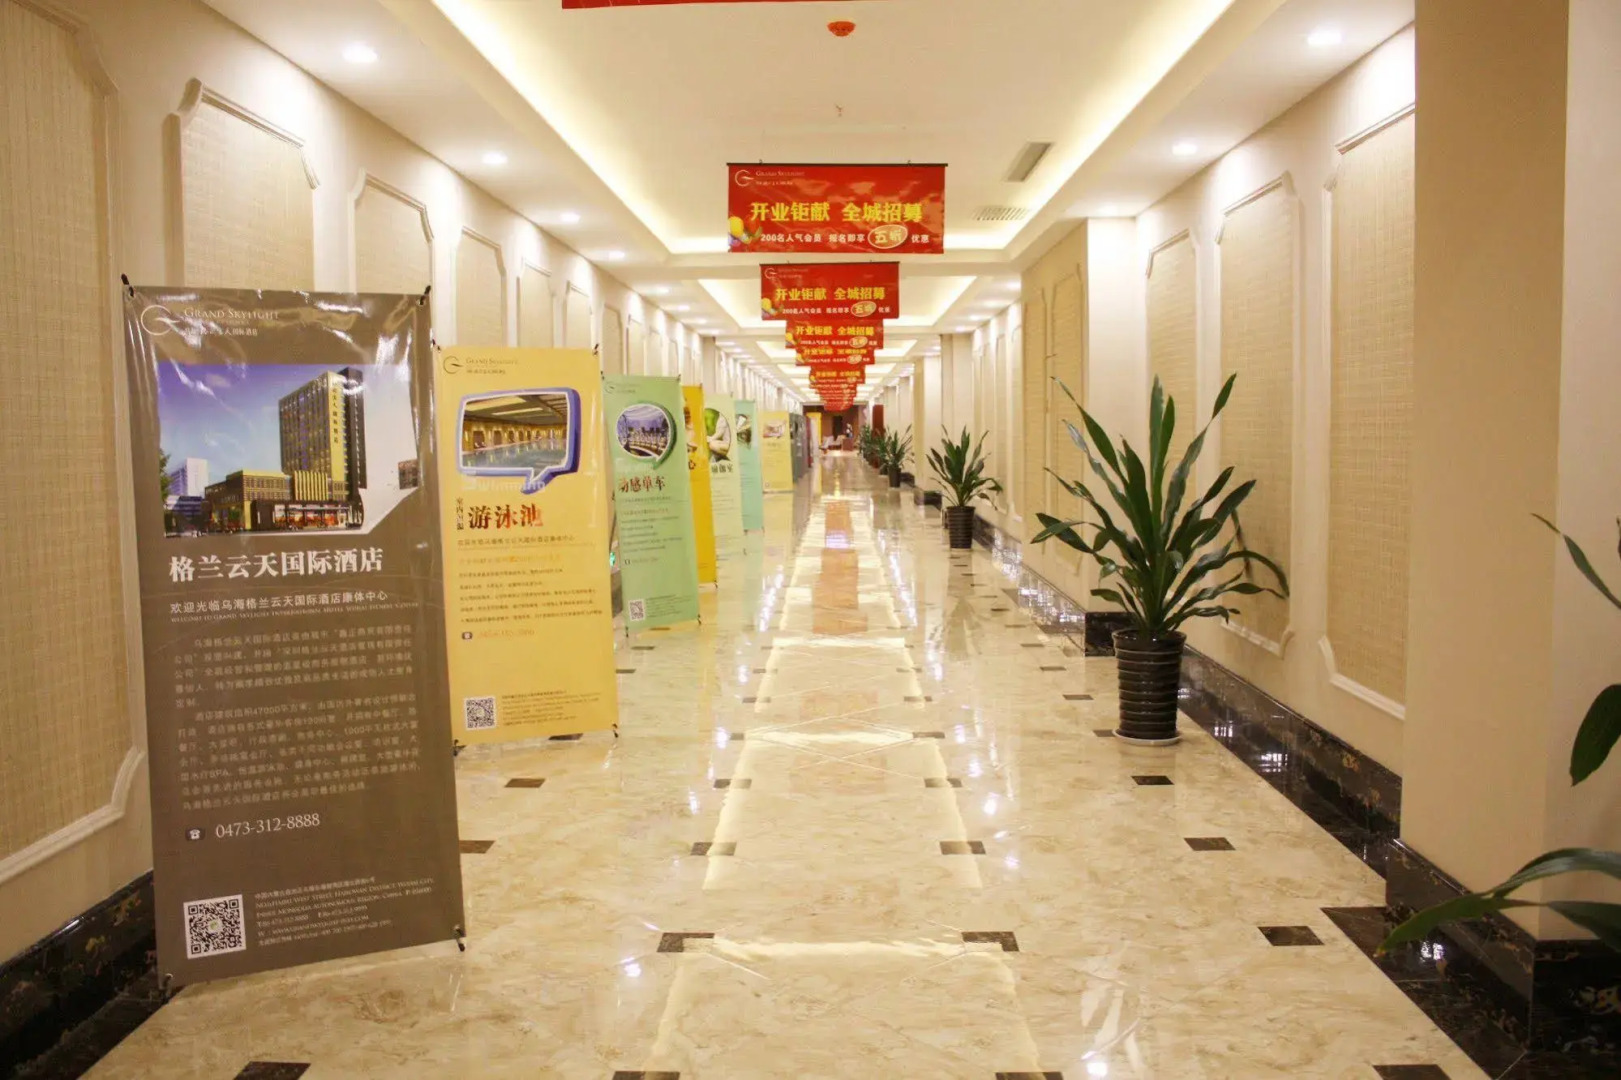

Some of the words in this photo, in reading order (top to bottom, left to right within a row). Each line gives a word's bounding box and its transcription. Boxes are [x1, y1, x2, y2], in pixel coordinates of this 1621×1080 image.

[751, 202, 830, 222] 开业钜献
[841, 202, 922, 223] 全城招募
[760, 233, 822, 243] 200名人气会员
[184, 306, 225, 318] GRAND
[468, 503, 544, 529] 游泳池
[168, 547, 383, 583] 格兰云天国际酒店
[215, 813, 320, 839] 0473-312-8888
